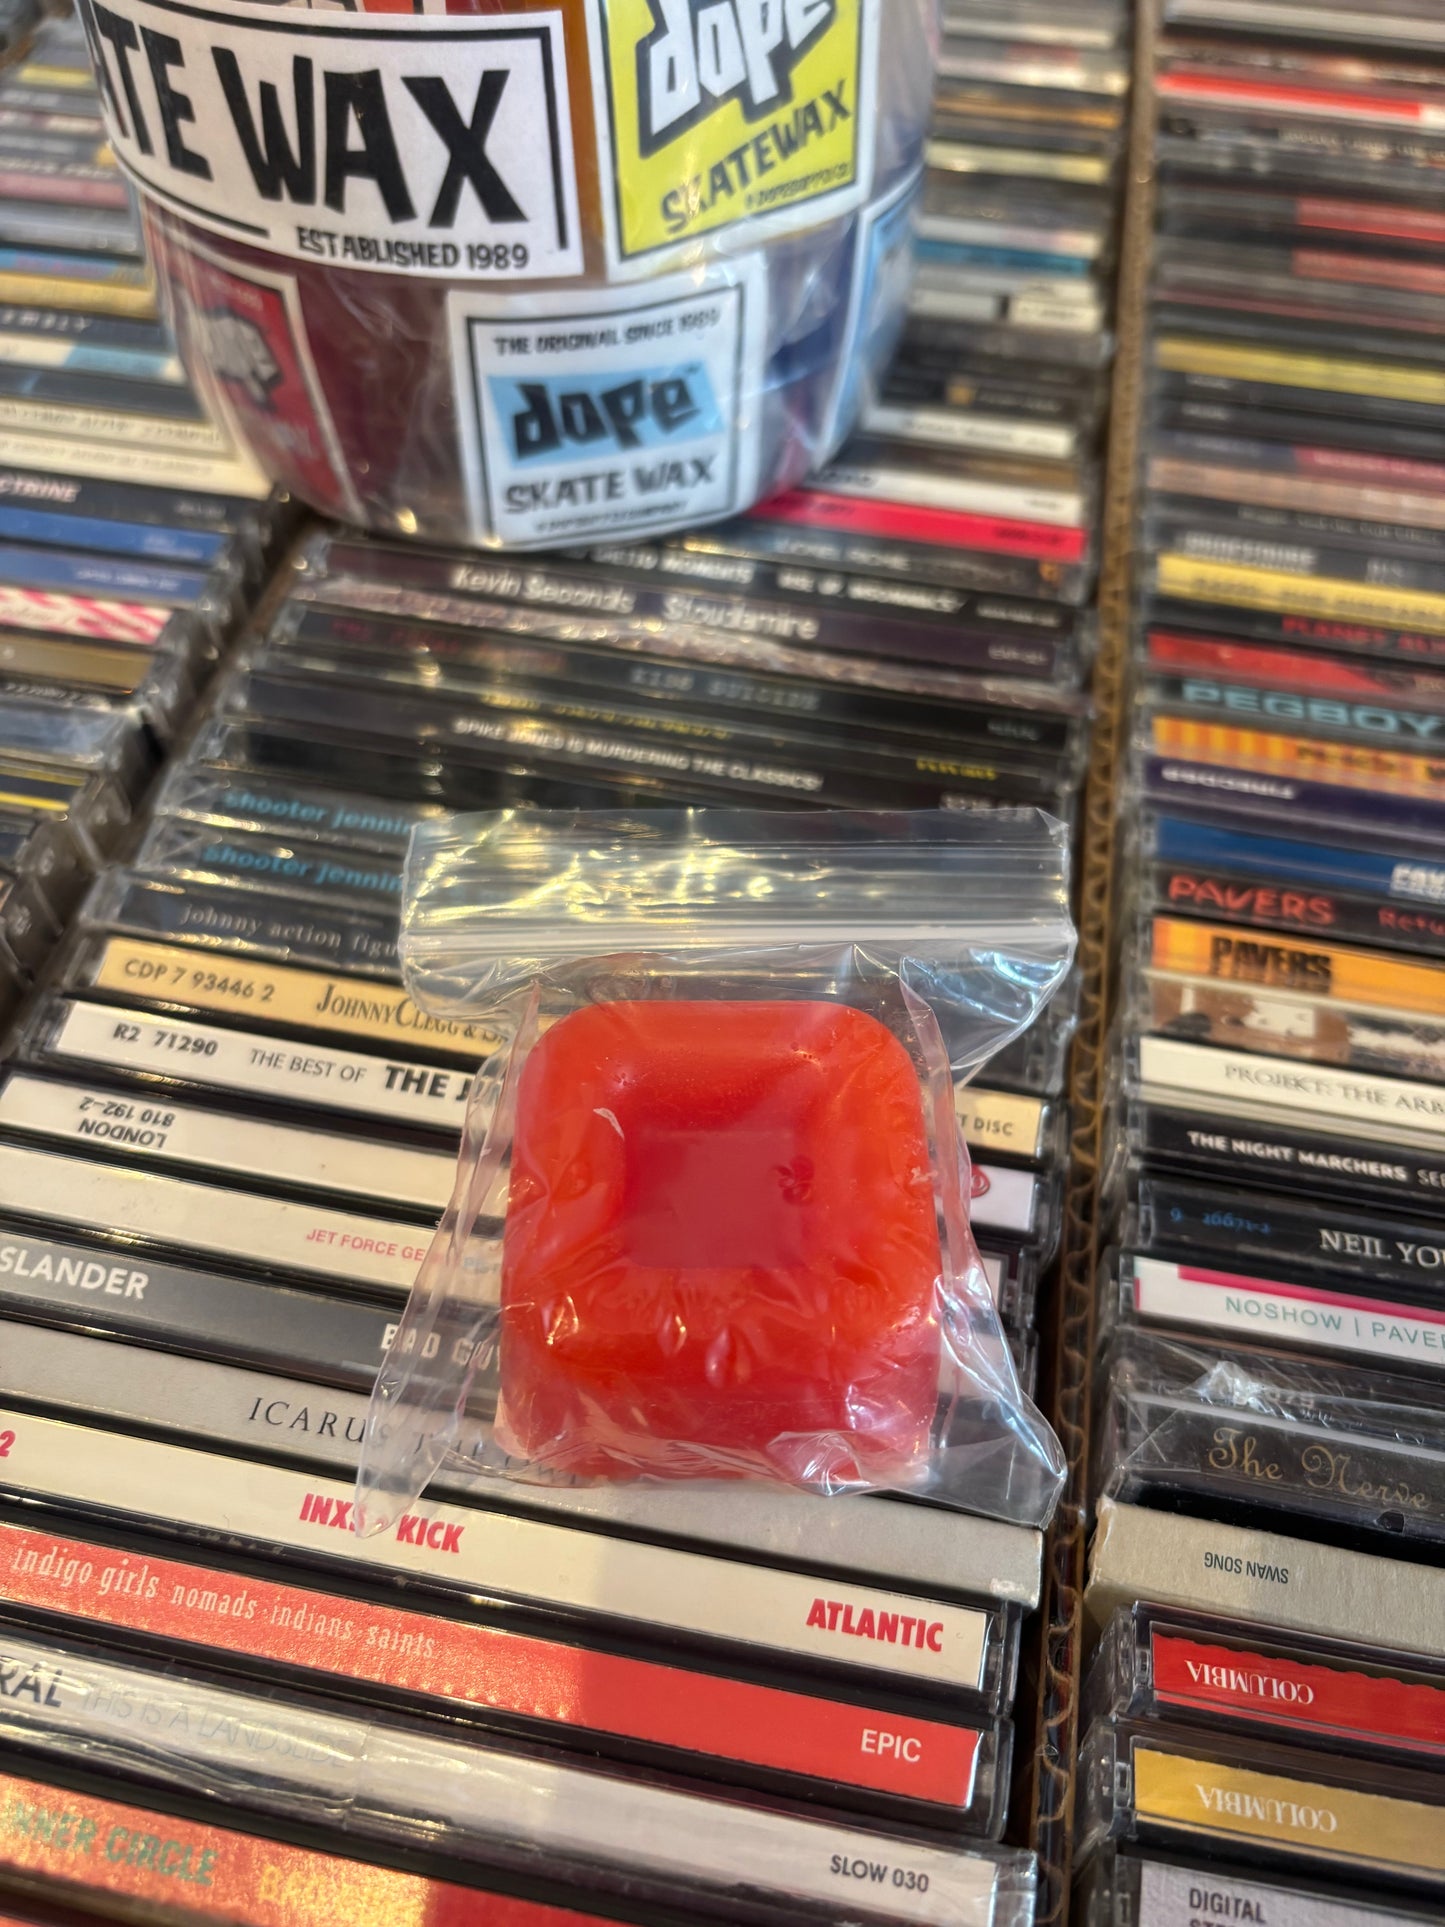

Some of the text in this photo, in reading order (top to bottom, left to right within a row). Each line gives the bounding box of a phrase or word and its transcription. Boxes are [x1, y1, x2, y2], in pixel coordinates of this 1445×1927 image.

[211, 46, 529, 229] WAX
[296, 225, 530, 271] ESTABLISHED 1989
[513, 376, 701, 461] dope
[505, 452, 719, 515] SKATE WAX
[1182, 679, 1442, 738] PEGBOY
[223, 791, 413, 836] shooter jennin
[203, 845, 403, 893] shooter jennin
[1168, 873, 1336, 925] PAVERS
[181, 904, 262, 937] johnny
[270, 914, 341, 948] action
[124, 958, 169, 984] CDP
[171, 965, 186, 986] 7
[192, 969, 255, 1001] 93446
[260, 984, 275, 1002] 2
[112, 1022, 140, 1044] R2
[153, 1028, 218, 1057] 71290
[248, 1048, 286, 1070] THE
[289, 1053, 338, 1079] BEST
[340, 1061, 367, 1083] OF
[385, 1064, 450, 1098] THE
[79, 1096, 177, 1127] 810 192-2
[1336, 1083, 1387, 1105] THE
[78, 1118, 167, 1149] LONDON
[974, 1118, 1014, 1137] DISC
[1187, 1130, 1227, 1152] THE
[1231, 1138, 1294, 1164] NIGHT
[1298, 1150, 1408, 1182] MARCHERS
[306, 1228, 338, 1245] JET
[340, 1233, 398, 1259] FORCE
[1170, 1208, 1183, 1222] 9
[1319, 1228, 1392, 1261] NEIL
[1396, 1241, 1445, 1268] YO
[0, 1246, 149, 1300] SLANDER
[1225, 1296, 1445, 1350] NOSHOW PAVE
[381, 1323, 501, 1372] BAD GU
[1209, 1426, 1431, 1510] The Nerve
[396, 1513, 465, 1553] KICK
[1203, 1551, 1289, 1584] SWAN SONG
[10, 1538, 436, 1661] indigo girls nomads indians saints
[806, 1597, 944, 1653] ATLANTIC
[1185, 1659, 1314, 1705] COLUMBIA
[83, 1687, 133, 1720] THIS
[141, 1698, 163, 1725] IS
[169, 1703, 190, 1730] A
[860, 1728, 922, 1764] EPIC
[1195, 1783, 1338, 1833] COLUMBIA
[106, 1826, 219, 1887] CIRCLE
[830, 1854, 929, 1893] SLOW 030
[1189, 1887, 1267, 1924] DIGITAL
